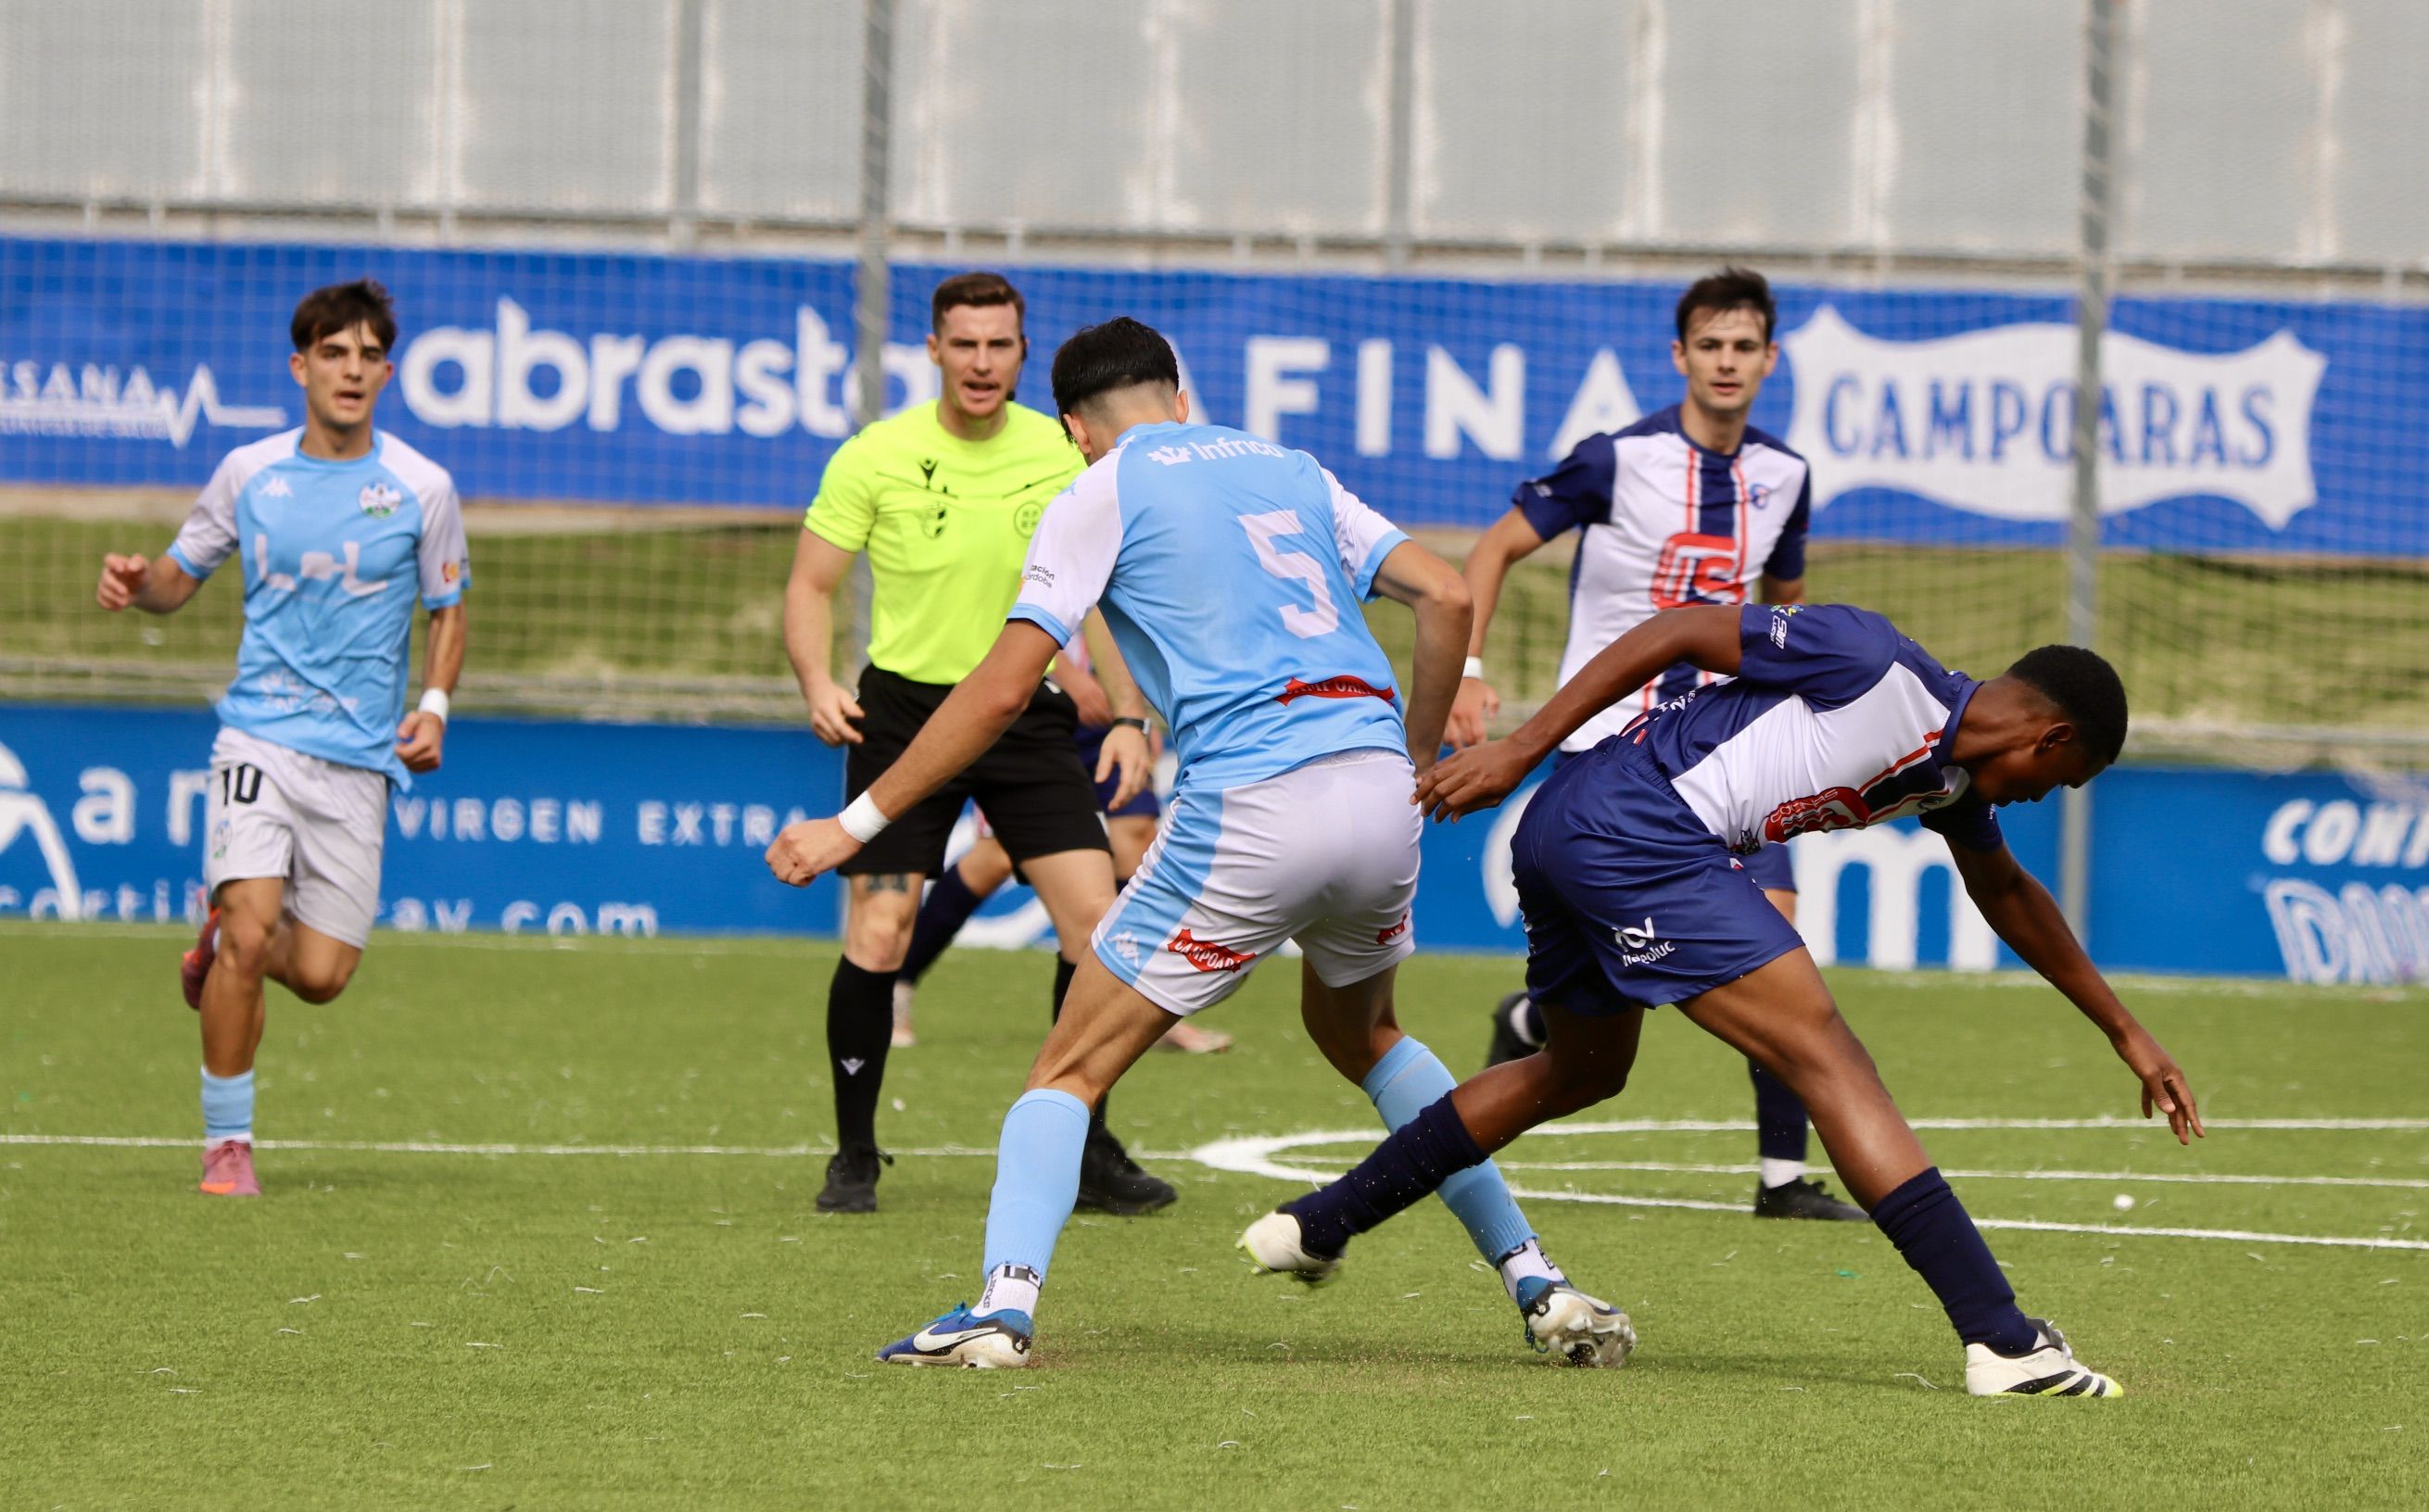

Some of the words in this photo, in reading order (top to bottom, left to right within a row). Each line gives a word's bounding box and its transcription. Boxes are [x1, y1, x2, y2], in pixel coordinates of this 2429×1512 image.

[1824, 374, 2275, 468] CAMPOARAS
[1188, 436, 1284, 460] Infrico
[1236, 510, 1339, 639] 5
[221, 762, 263, 805] 10
[393, 796, 602, 844] VIRGEN
